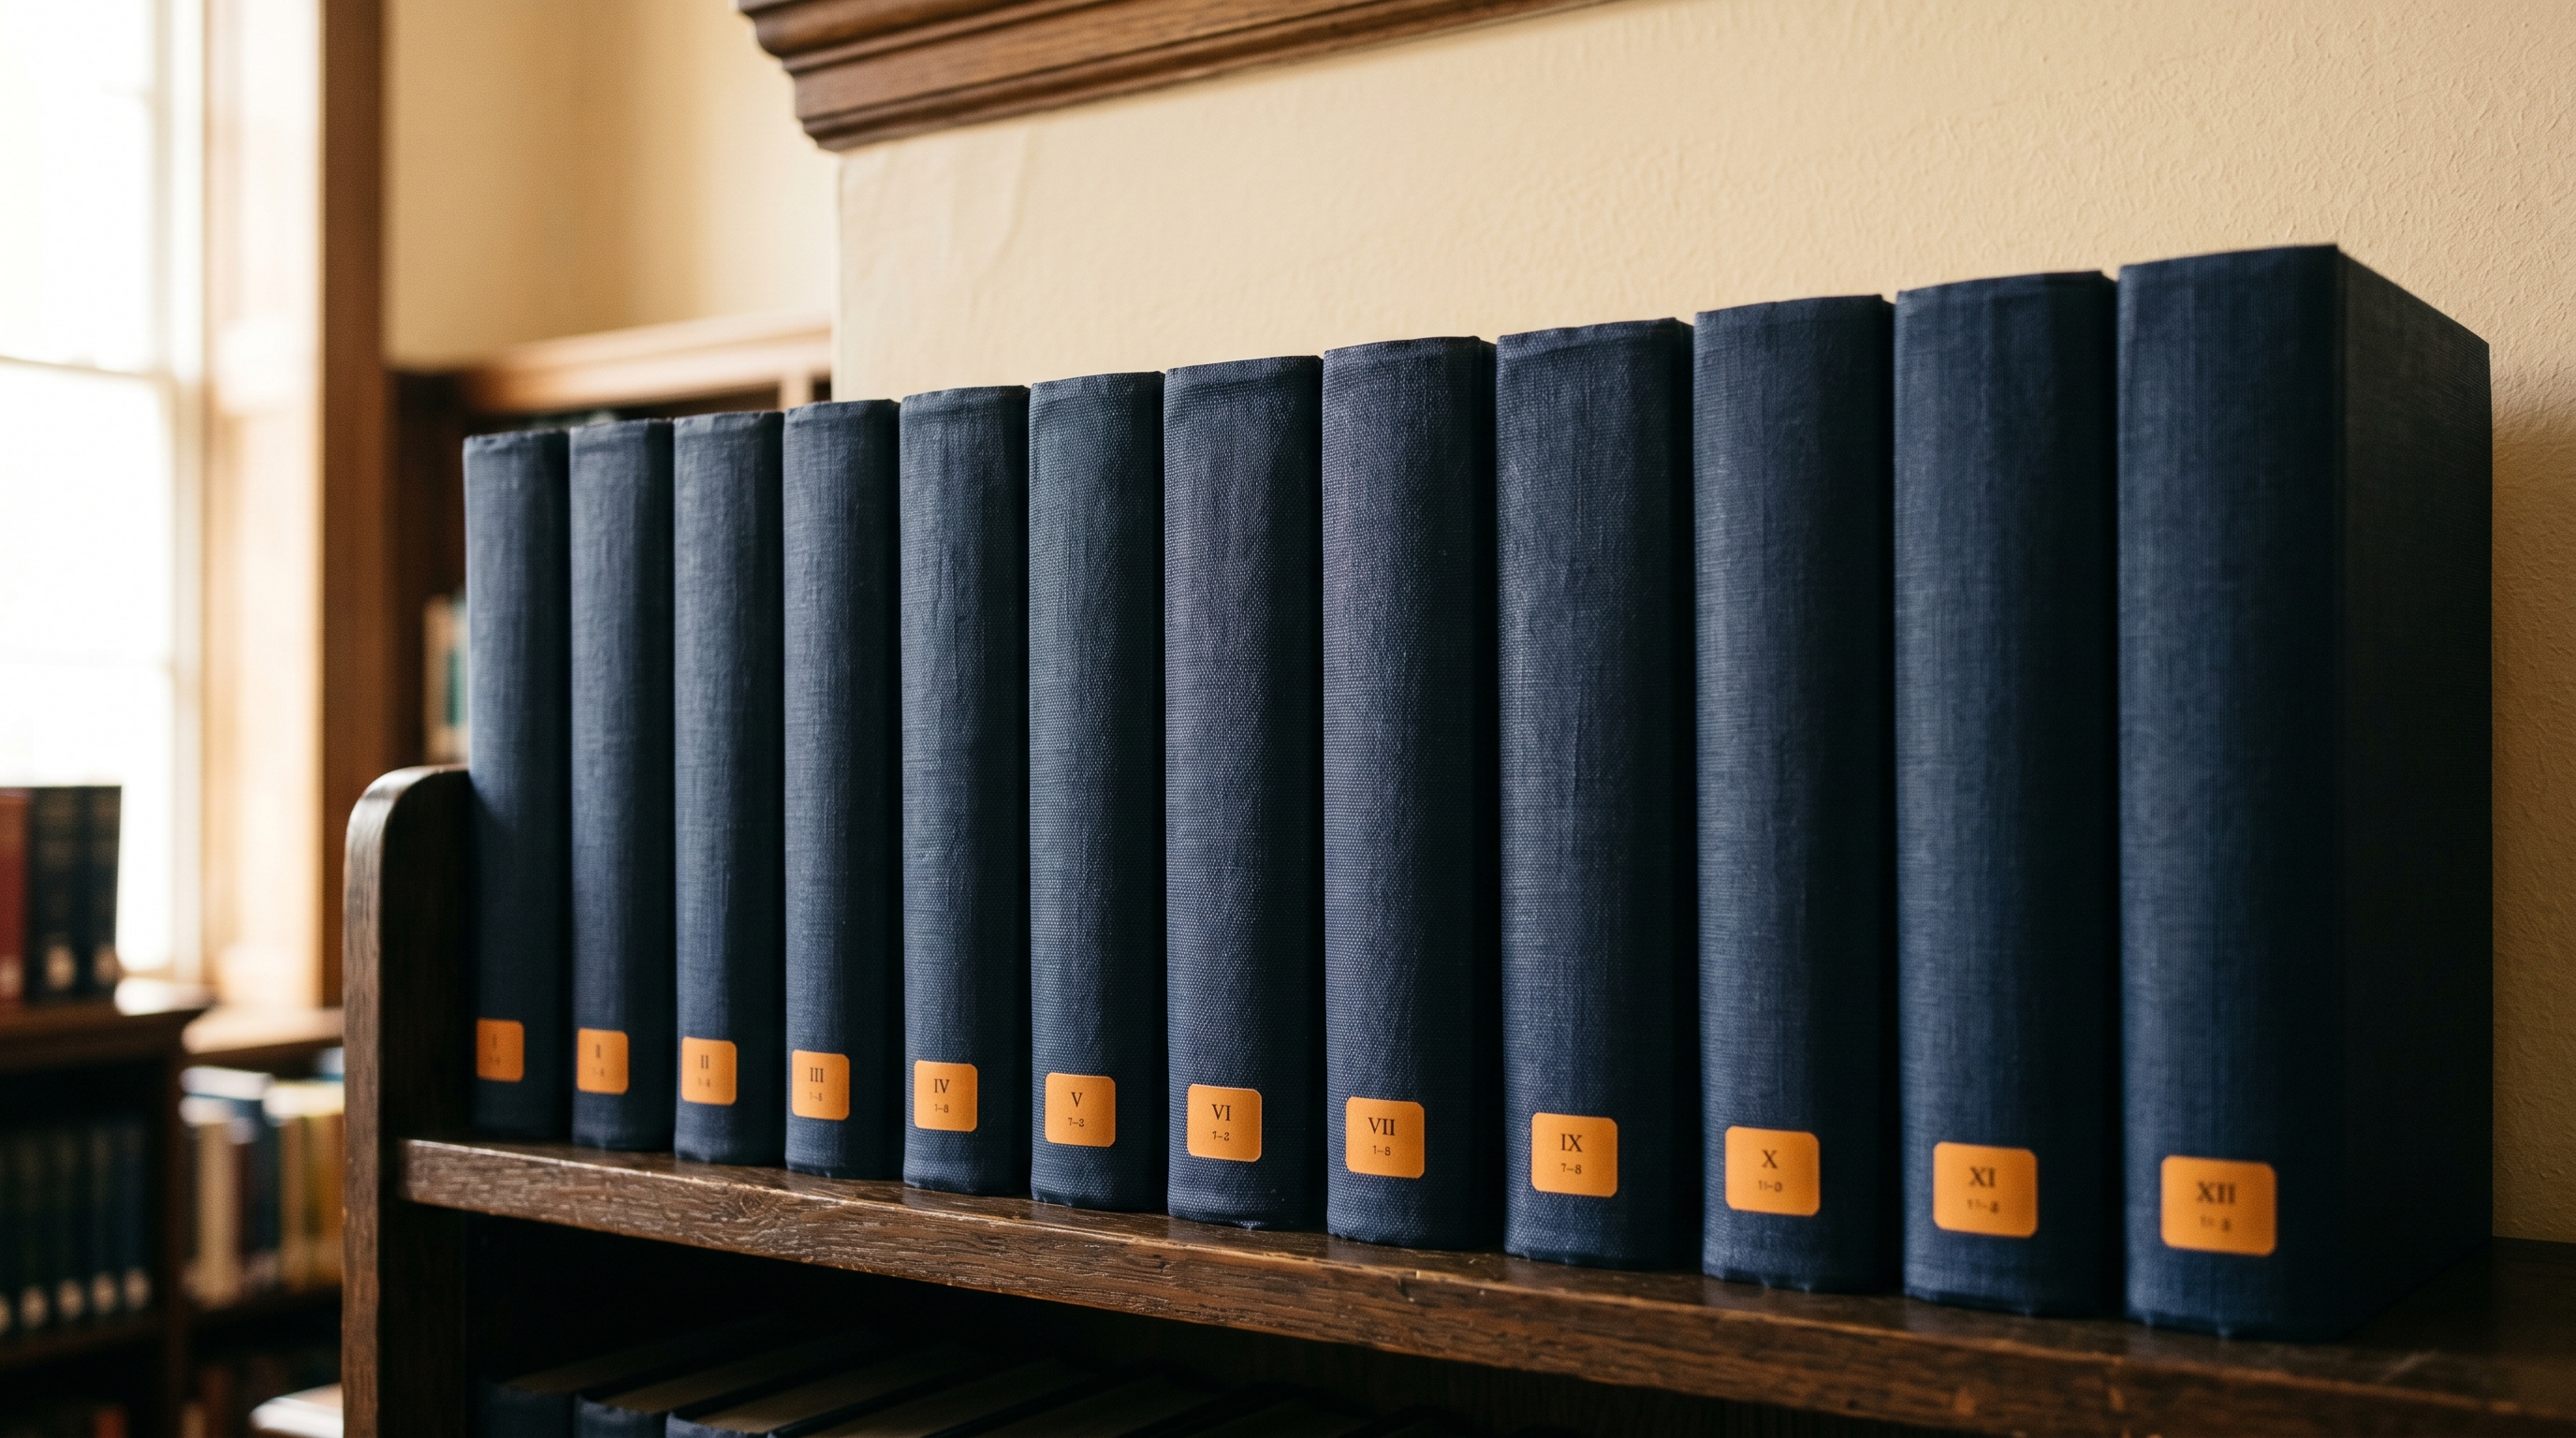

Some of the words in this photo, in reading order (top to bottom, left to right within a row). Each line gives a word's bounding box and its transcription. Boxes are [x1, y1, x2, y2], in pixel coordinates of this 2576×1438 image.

[700, 1054, 710, 1069] II
[810, 1067, 825, 1083] III
[934, 1078, 950, 1093] IV
[1071, 1092, 1083, 1108] V
[1211, 1104, 1231, 1122] VI
[1368, 1117, 1396, 1136] VII
[1560, 1133, 1583, 1152] IX
[1762, 1149, 1778, 1169] X
[1969, 1166, 1996, 1188] XI
[2196, 1181, 2236, 1205] XII
